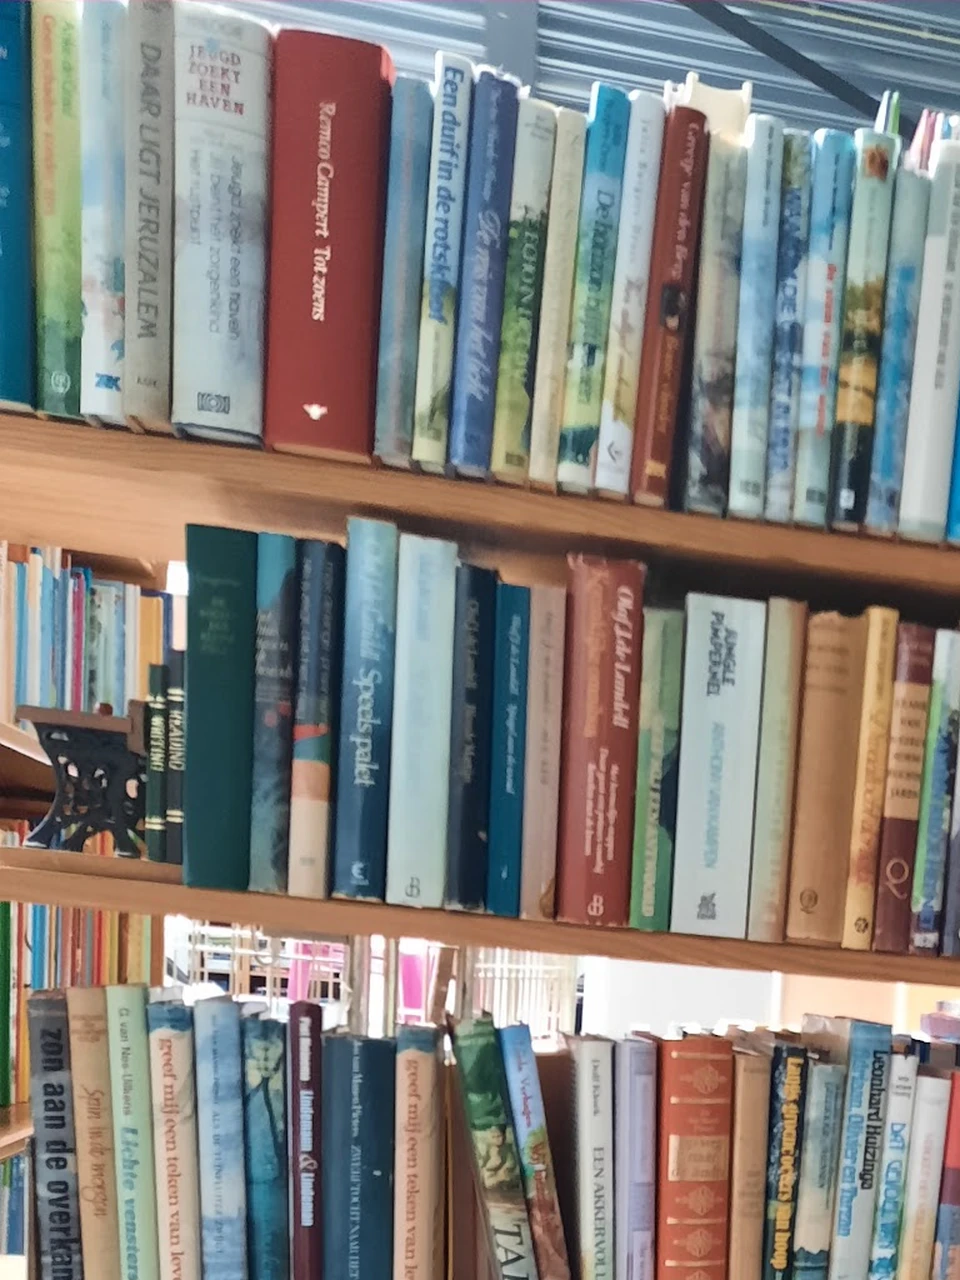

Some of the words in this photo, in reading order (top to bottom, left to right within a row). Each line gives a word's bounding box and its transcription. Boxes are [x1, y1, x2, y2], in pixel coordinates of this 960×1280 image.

[138, 43, 162, 113] DAAR
[441, 66, 465, 110] Een
[139, 125, 160, 181] LIGT
[317, 103, 337, 160] Remco
[438, 113, 462, 160] duif
[313, 162, 334, 237] Campert
[435, 186, 456, 213] de
[138, 188, 161, 339] JERUZALEM
[313, 247, 331, 275] Tot
[311, 276, 326, 321] zoens
[706, 610, 725, 698] PIMPERNEL
[721, 628, 739, 687] JUNGLE
[352, 667, 383, 733] Speels
[147, 716, 166, 772] WRITING
[167, 711, 187, 771] READING
[348, 736, 379, 788] palet
[40, 1028, 65, 1072] zon
[158, 1038, 179, 1081] geef
[159, 1084, 180, 1116] mij
[403, 1059, 423, 1102] geef
[867, 1050, 890, 1122] Leonhard
[42, 1083, 67, 1129] aan
[300, 1089, 315, 1153] Lindemann
[403, 1104, 423, 1134] mij
[45, 1140, 75, 1171] de
[121, 1127, 140, 1190] Lichte
[164, 1119, 177, 1152] een
[405, 1137, 419, 1168] een
[858, 1125, 884, 1191] Huizinga
[166, 1156, 184, 1206] teken
[298, 1154, 319, 1170] &
[591, 1146, 605, 1180] EEN
[300, 1172, 315, 1227] Lindeman
[405, 1173, 422, 1224] teken
[168, 1210, 180, 1246] van
[404, 1227, 416, 1261] van
[770, 1232, 792, 1270] hoop
